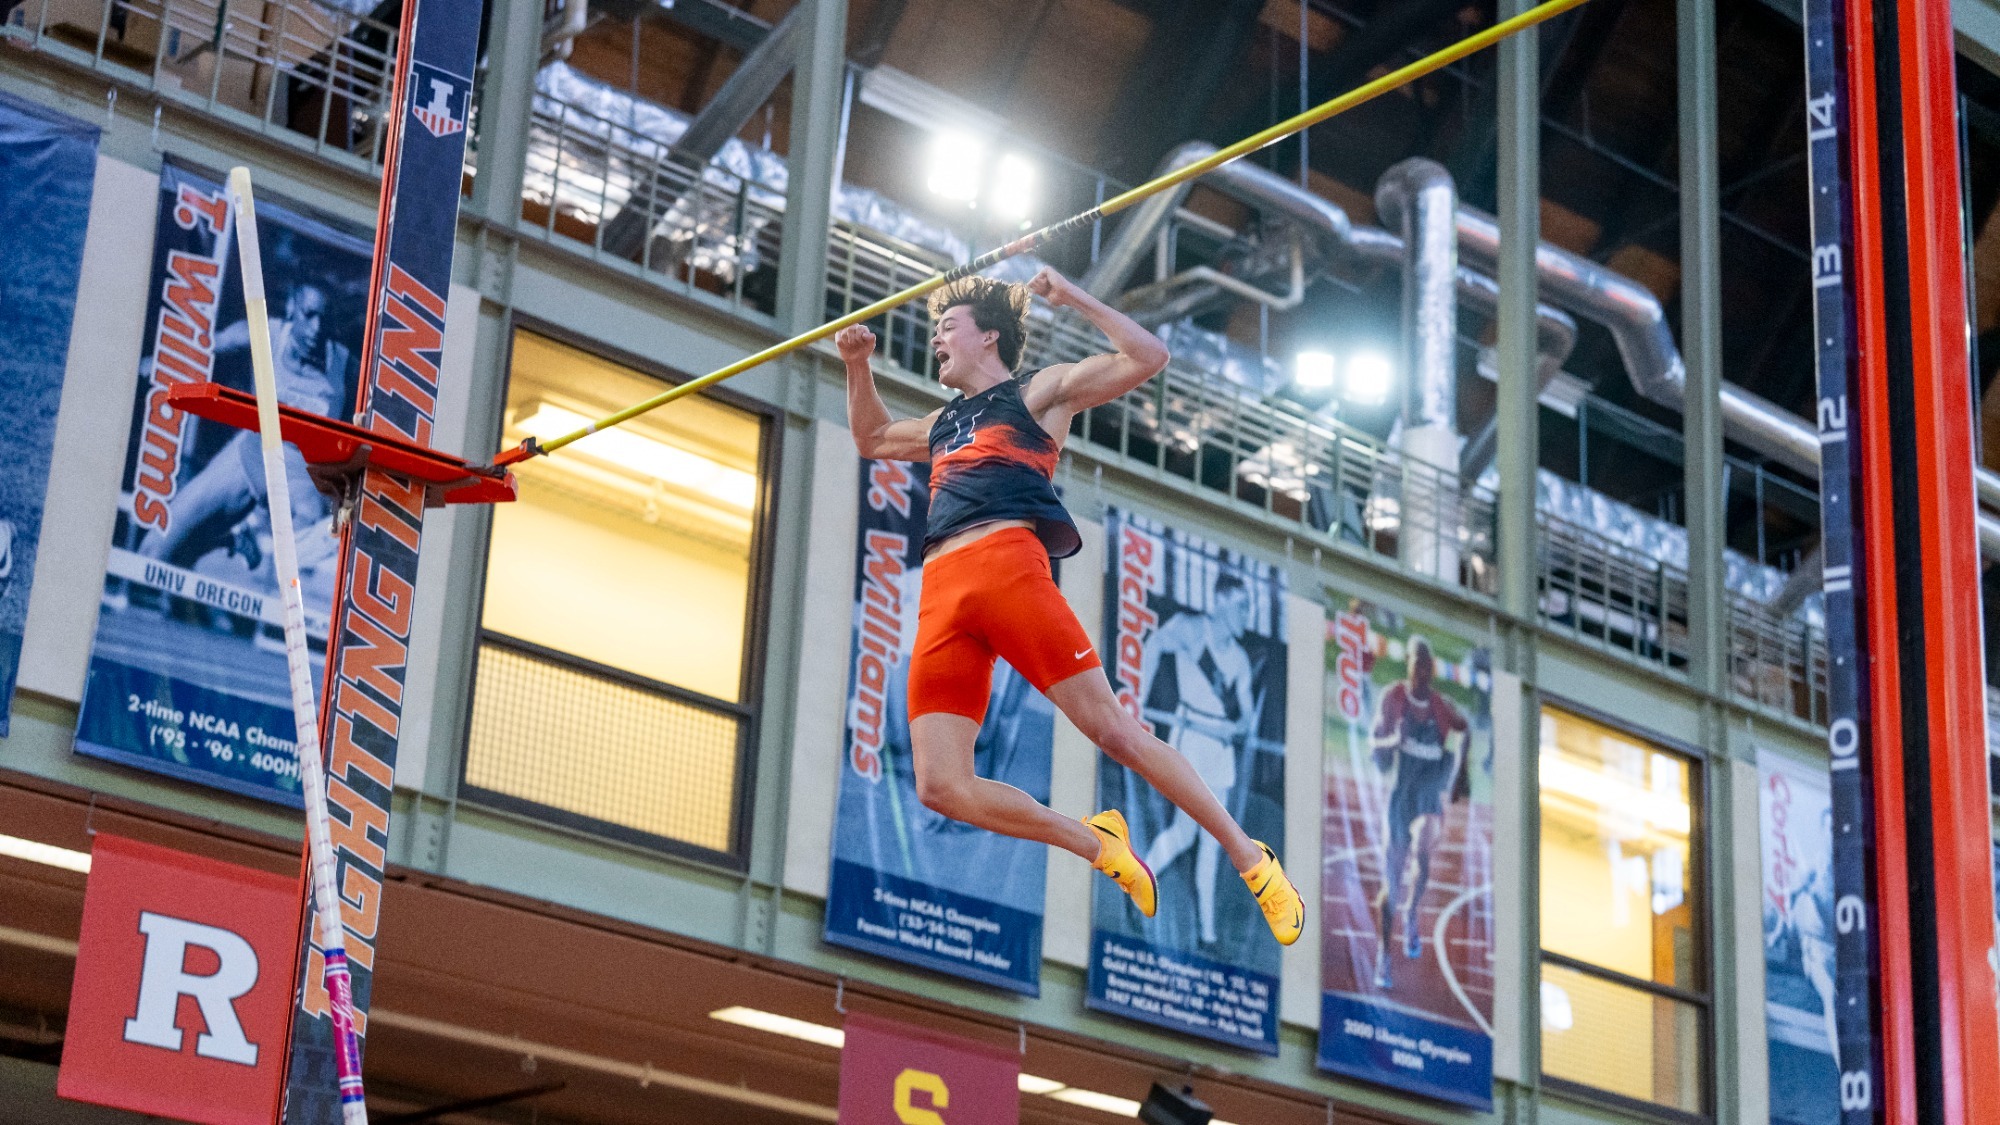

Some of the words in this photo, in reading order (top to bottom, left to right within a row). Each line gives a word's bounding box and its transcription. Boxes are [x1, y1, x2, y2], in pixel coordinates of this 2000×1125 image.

[1809, 92, 1836, 141] 14
[174, 183, 228, 233] T.
[1814, 243, 1842, 288] 13
[134, 251, 220, 532] Williams
[1818, 395, 1848, 444] 12
[145, 563, 186, 592] UNIV
[195, 580, 263, 617] OREGON
[1823, 566, 1852, 592] 11
[852, 529, 908, 785] Williams
[127, 694, 184, 724] 2-time
[189, 711, 241, 740] NCAA
[245, 726, 300, 758] Champ
[150, 725, 186, 748] ('95
[204, 739, 234, 761] '96
[1829, 718, 1860, 770] 10
[302, 547, 414, 1039] FIGHTING
[910, 898, 944, 919] NCAA
[946, 908, 1000, 934] Champion
[1835, 895, 1866, 934] 9
[857, 917, 897, 940] Former
[899, 929, 934, 950] World
[935, 938, 973, 961] Record
[974, 949, 1012, 970] Holder
[122, 909, 260, 1068] R
[1840, 1070, 1871, 1110] 8
